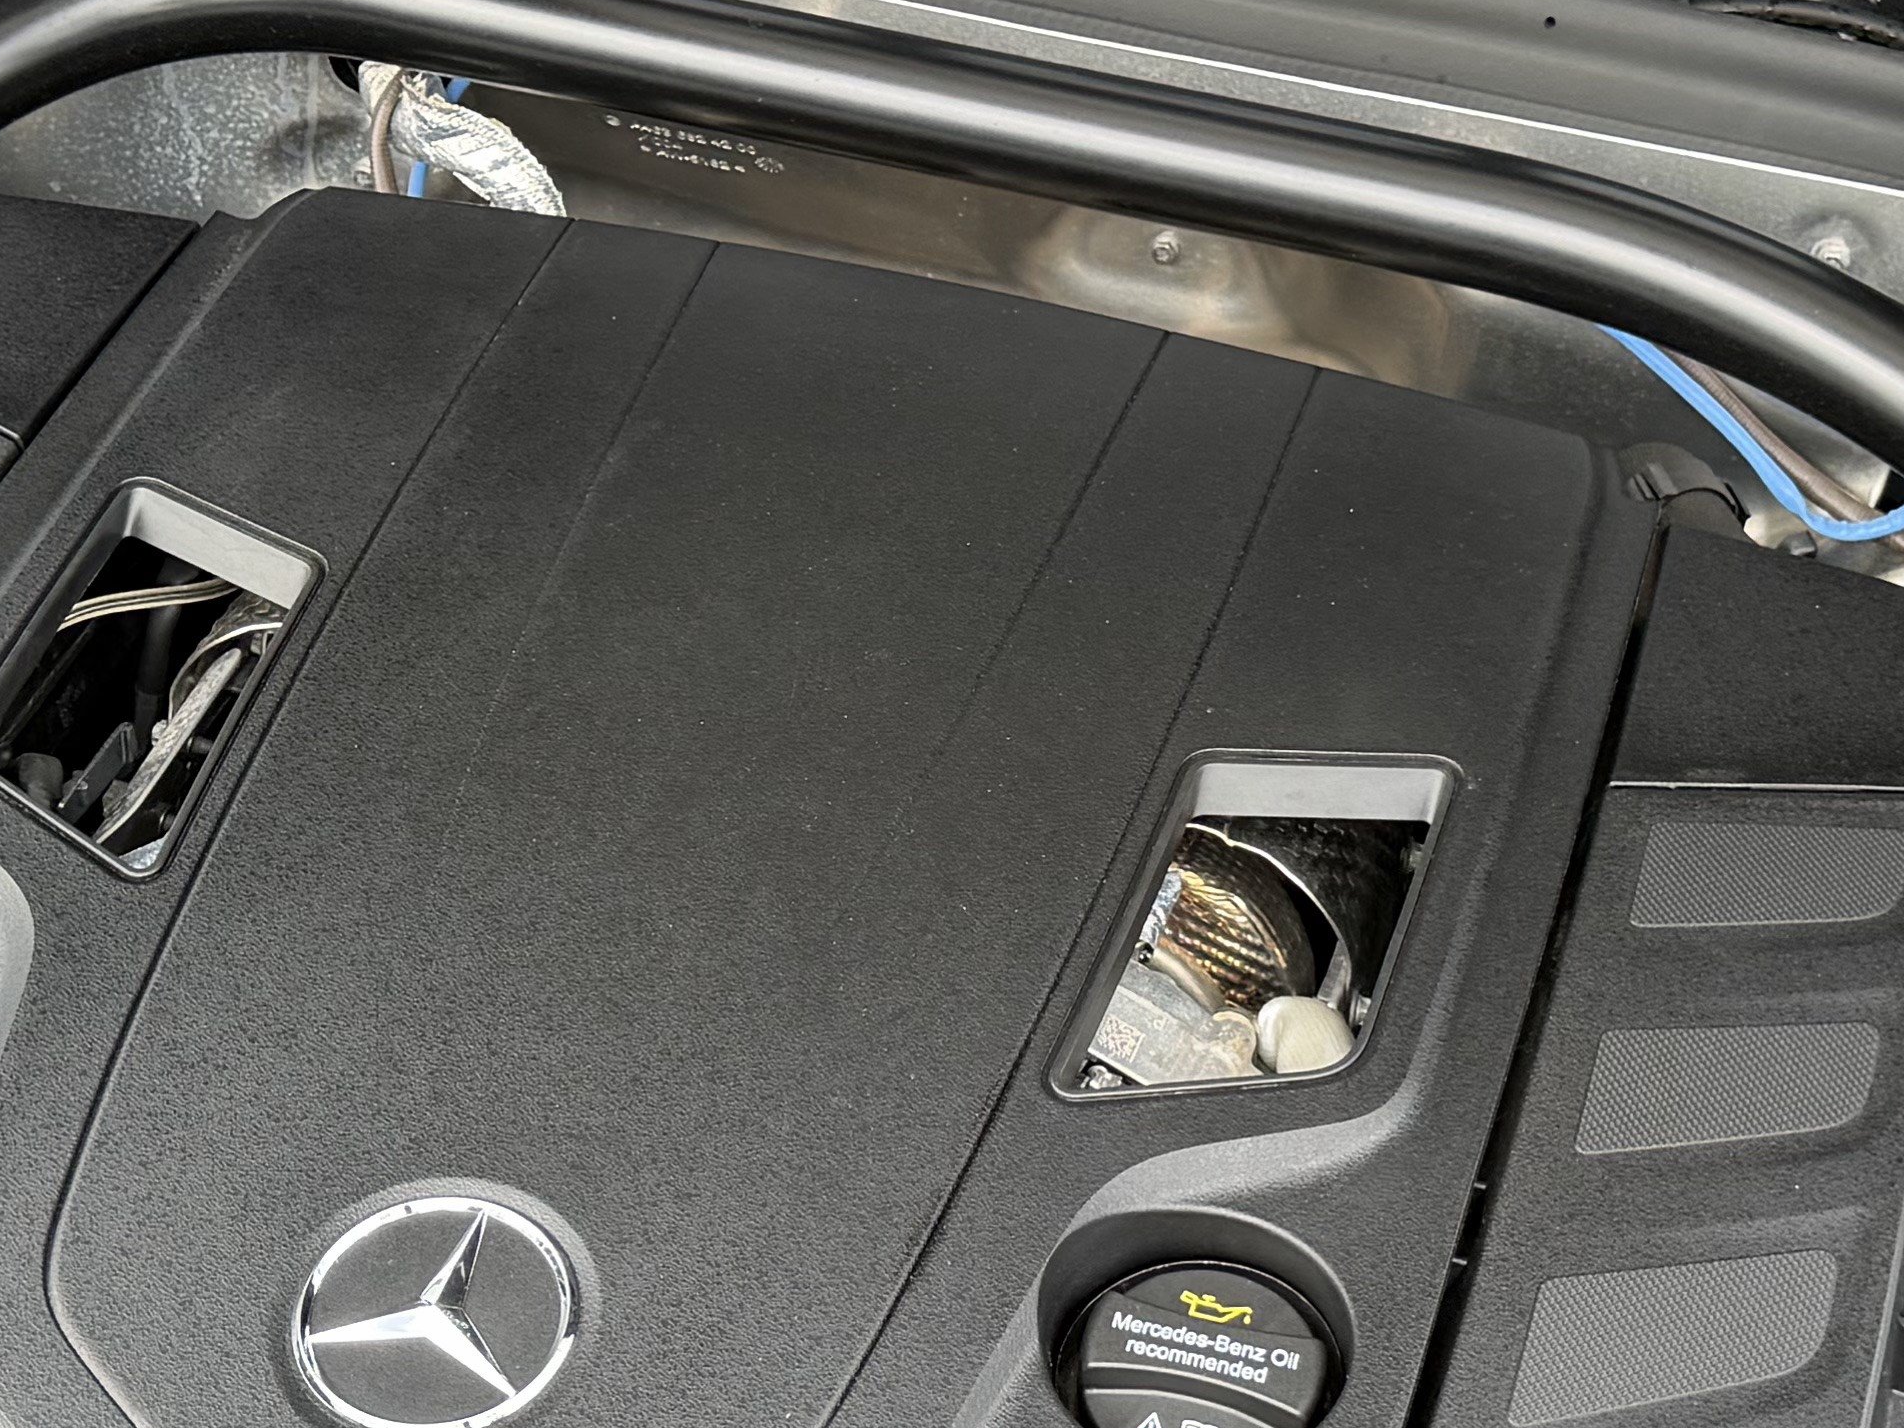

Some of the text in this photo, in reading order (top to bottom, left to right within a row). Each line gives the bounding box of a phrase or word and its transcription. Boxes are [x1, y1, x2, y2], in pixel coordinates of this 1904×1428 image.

[1111, 1310, 1301, 1371] Mercedes-Benz Oil
[1124, 1338, 1269, 1384] recommended
